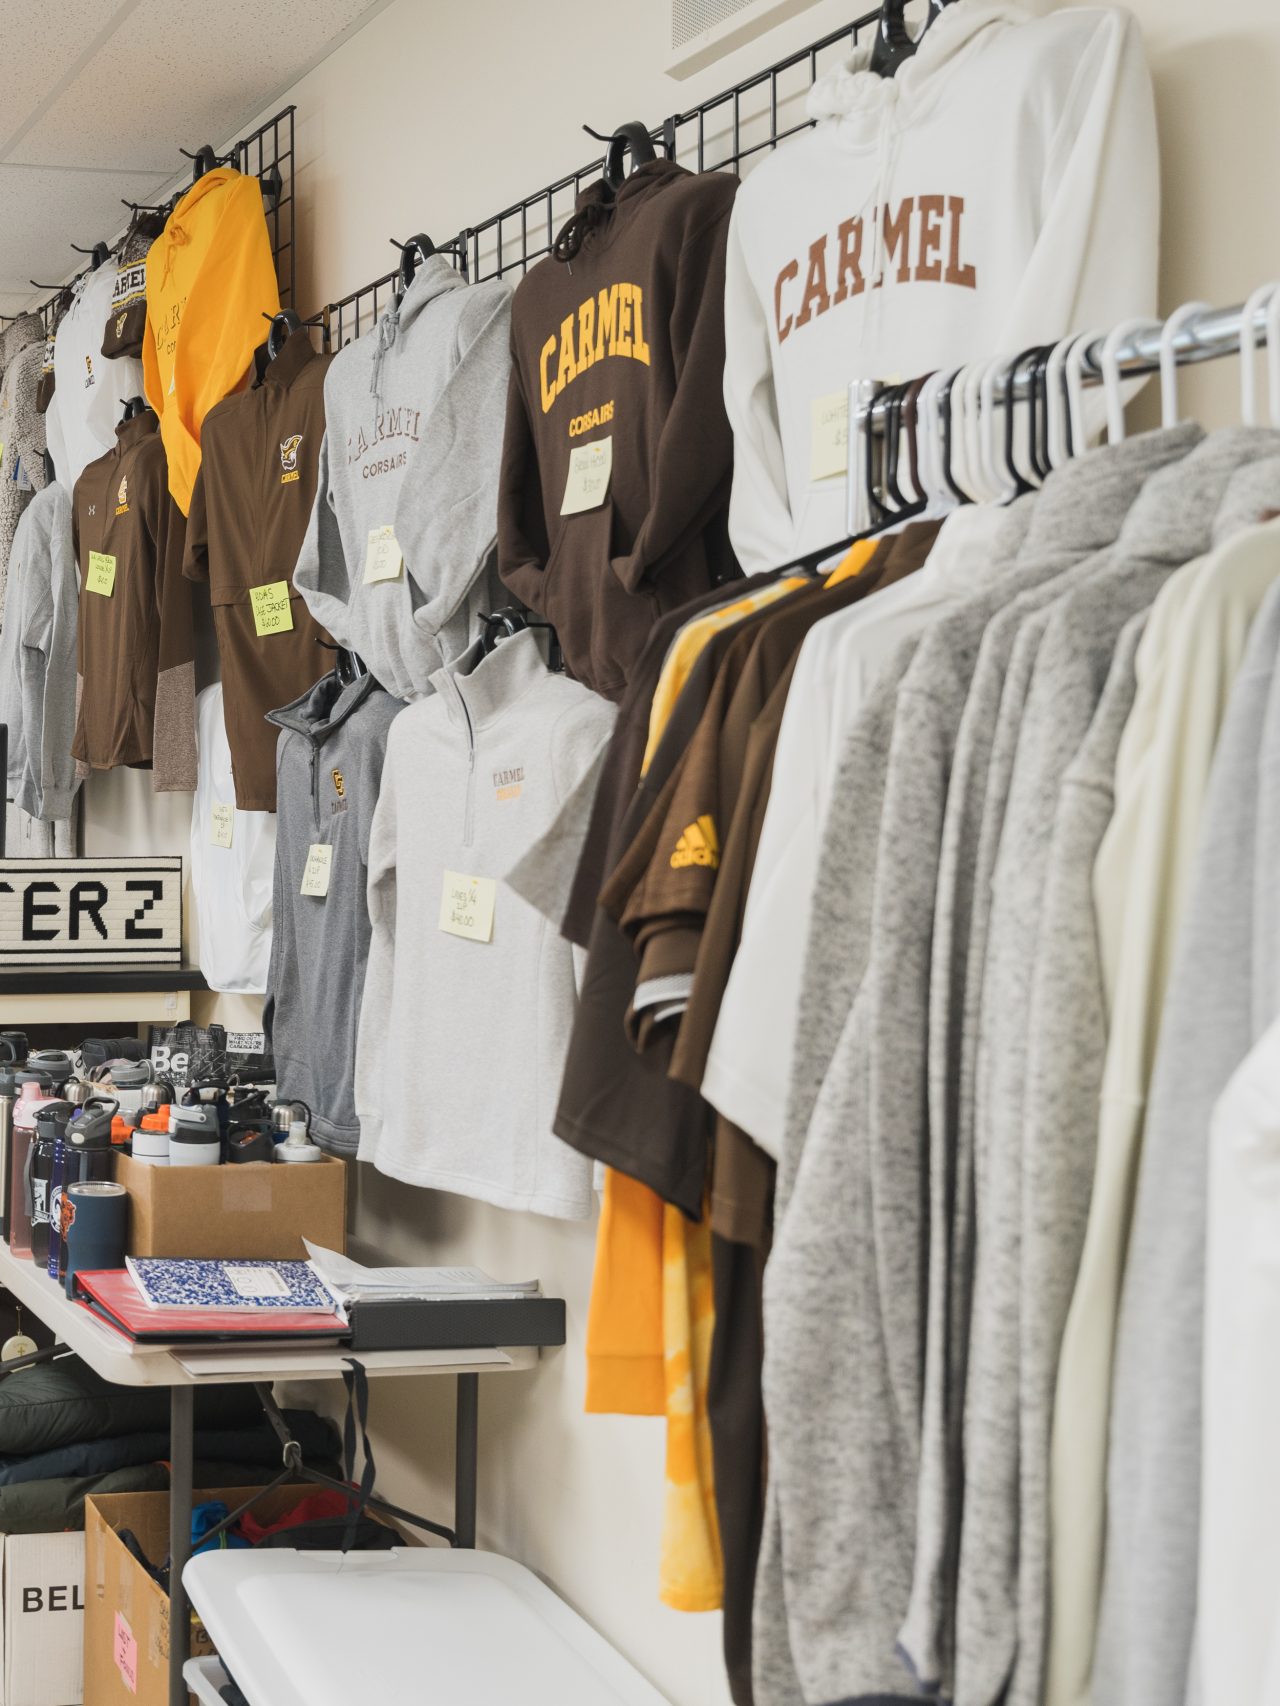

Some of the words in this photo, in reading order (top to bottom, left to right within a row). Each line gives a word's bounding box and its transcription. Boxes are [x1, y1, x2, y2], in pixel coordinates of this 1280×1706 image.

[775, 195, 976, 344] CARMEL
[540, 282, 651, 414] CARMEL
[569, 400, 615, 437] CORSAIRS
[362, 452, 407, 479] CORSAIRS
[151, 1046, 189, 1072] Be
